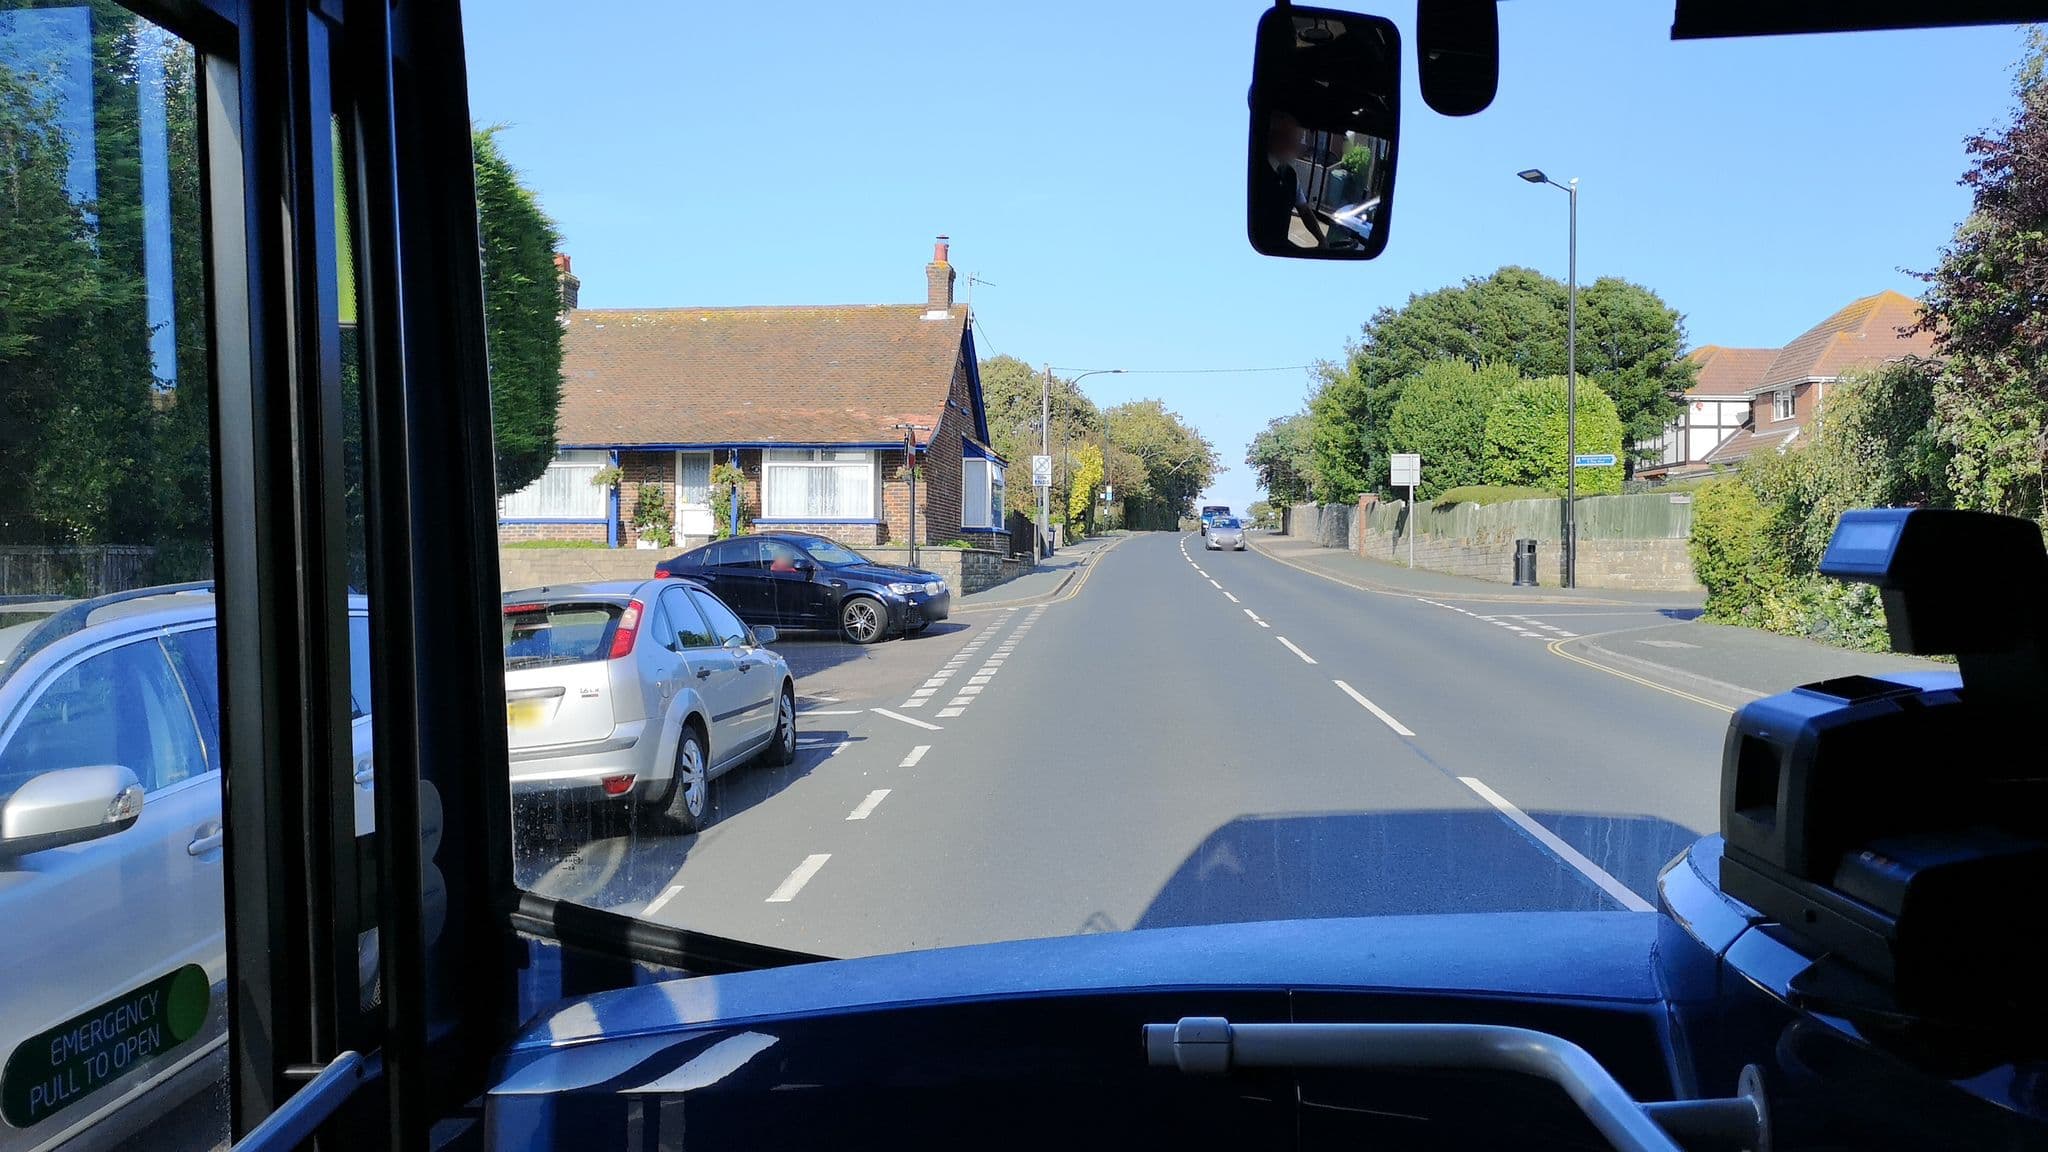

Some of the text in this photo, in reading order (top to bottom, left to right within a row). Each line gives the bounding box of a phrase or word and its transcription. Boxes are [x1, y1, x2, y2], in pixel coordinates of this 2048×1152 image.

[30, 1023, 160, 1116] PULL TO OPEN
[51, 990, 159, 1066] EMERGENCY
